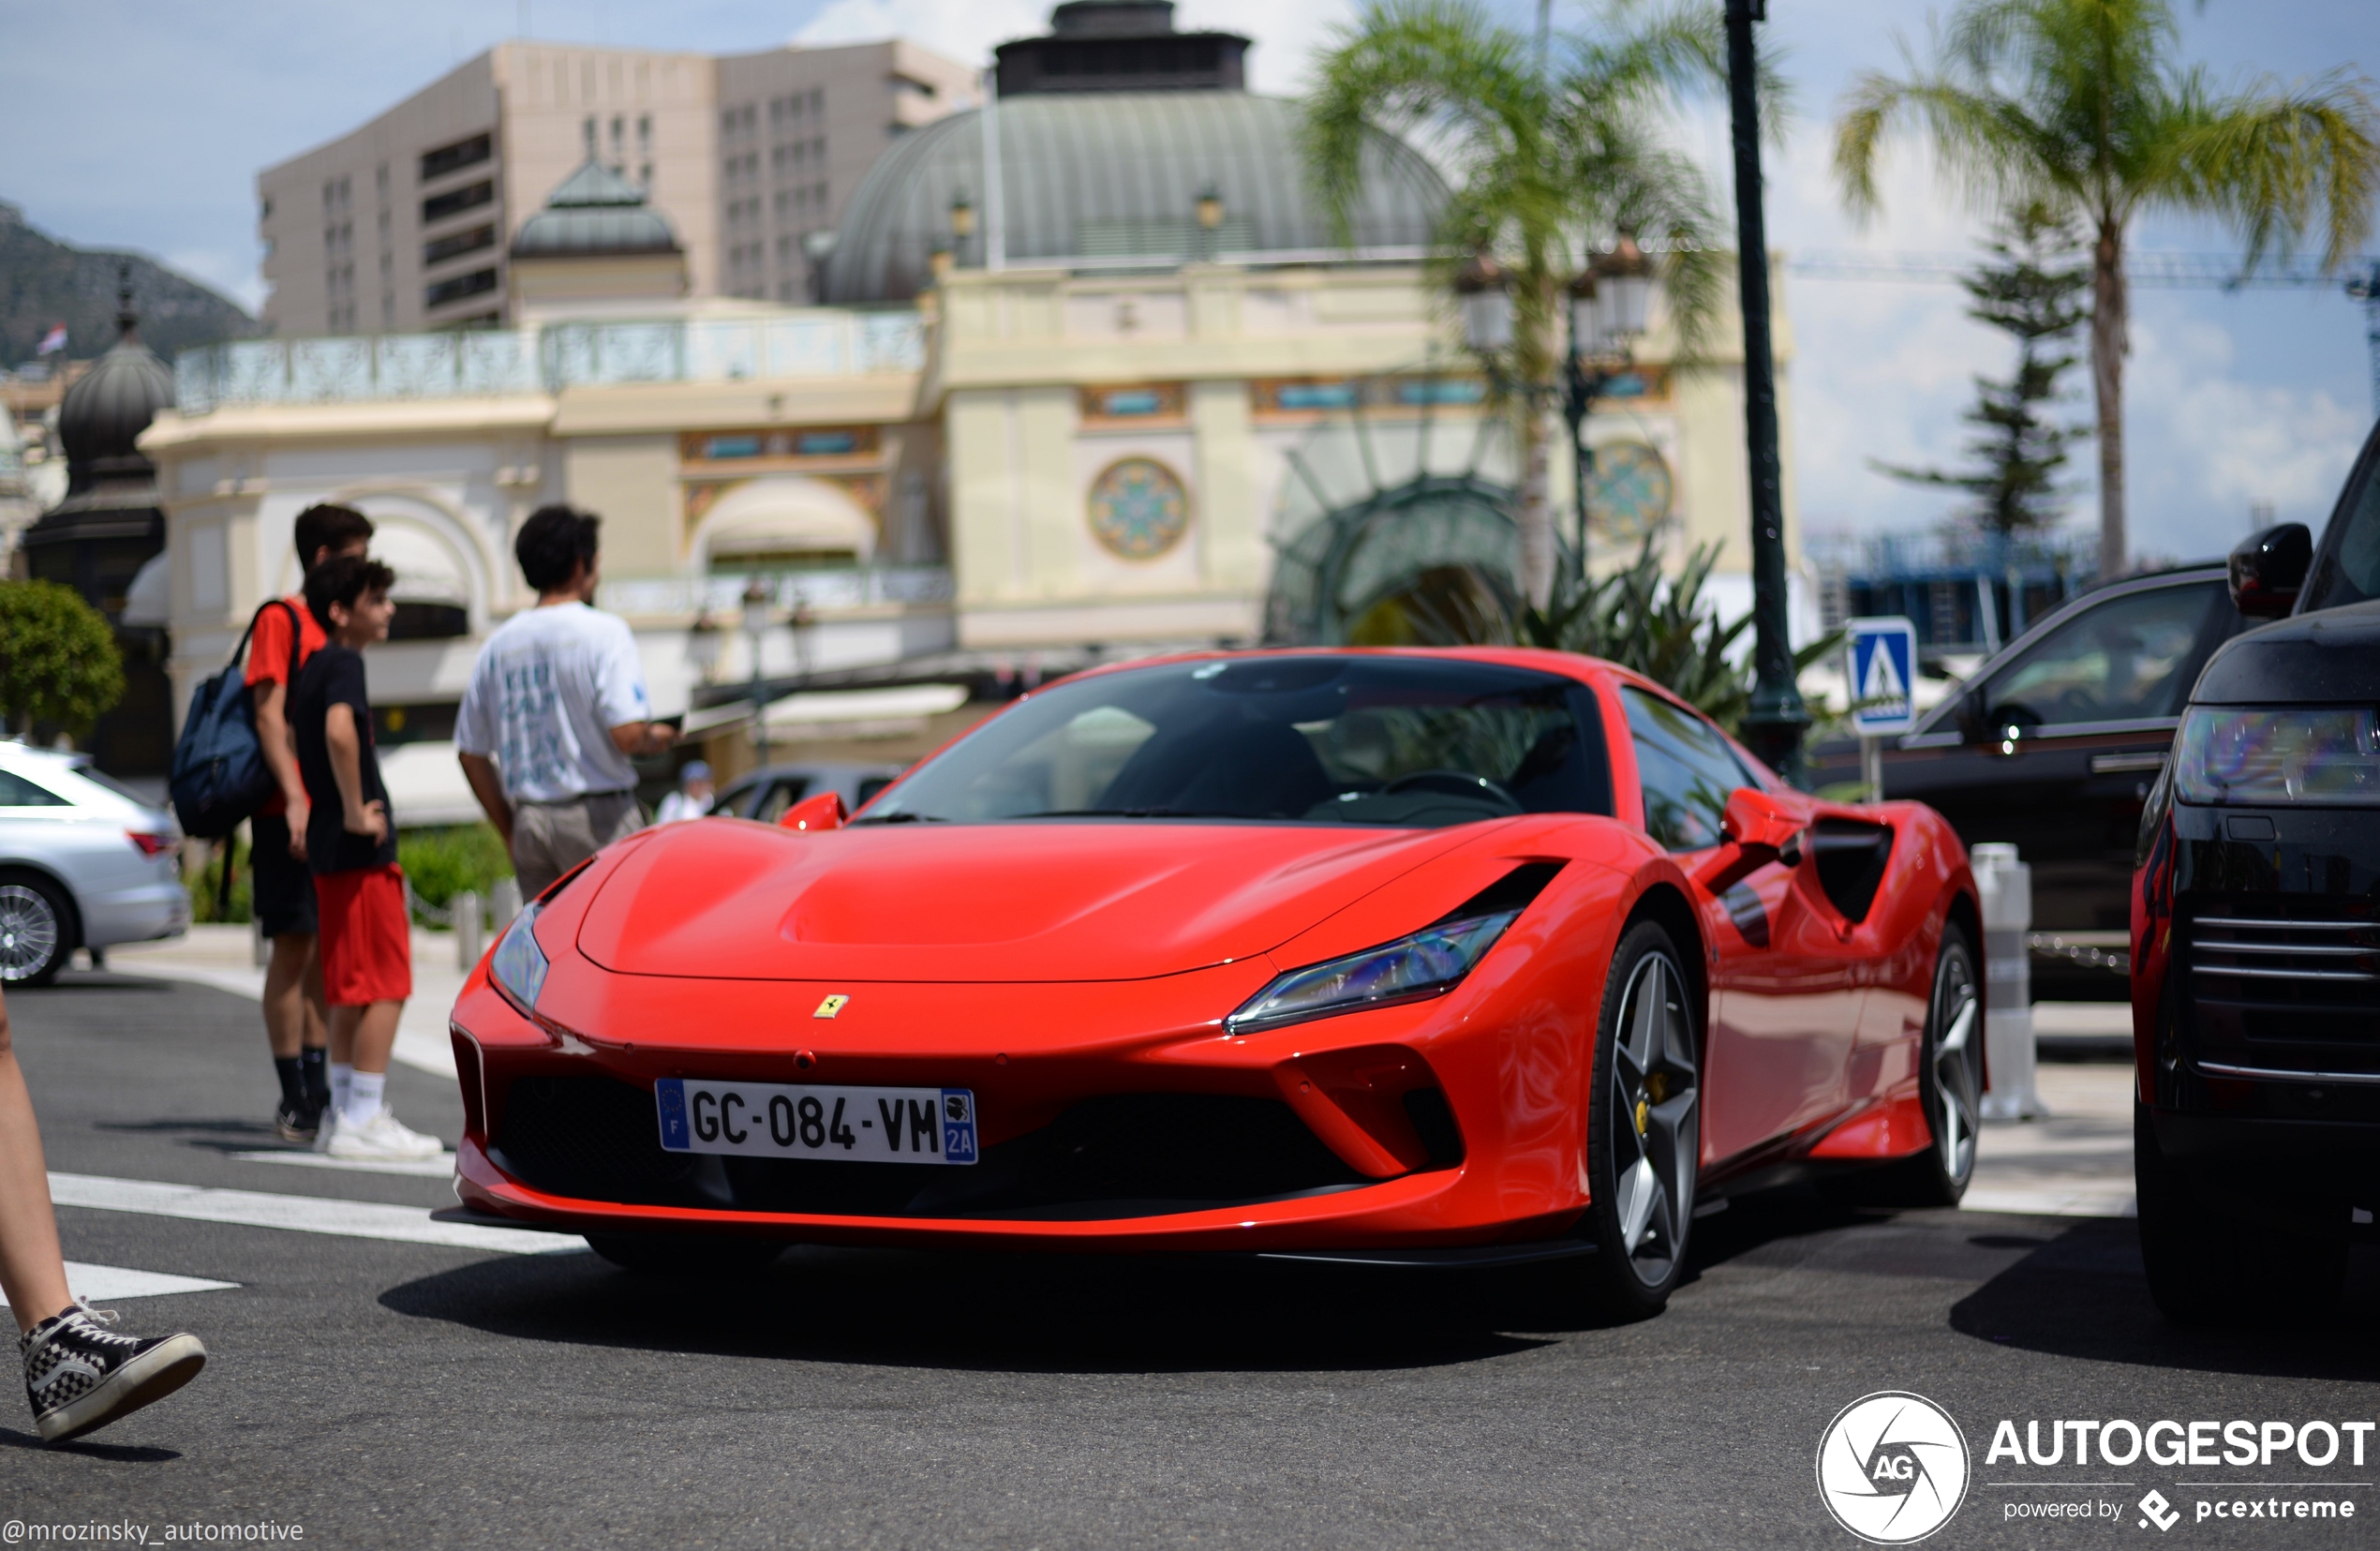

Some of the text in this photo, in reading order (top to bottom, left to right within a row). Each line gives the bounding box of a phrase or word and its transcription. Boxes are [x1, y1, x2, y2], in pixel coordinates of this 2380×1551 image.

[670, 1120, 678, 1134] F
[692, 1091, 939, 1152] GC-084-VM
[946, 1128, 973, 1154] 2A
